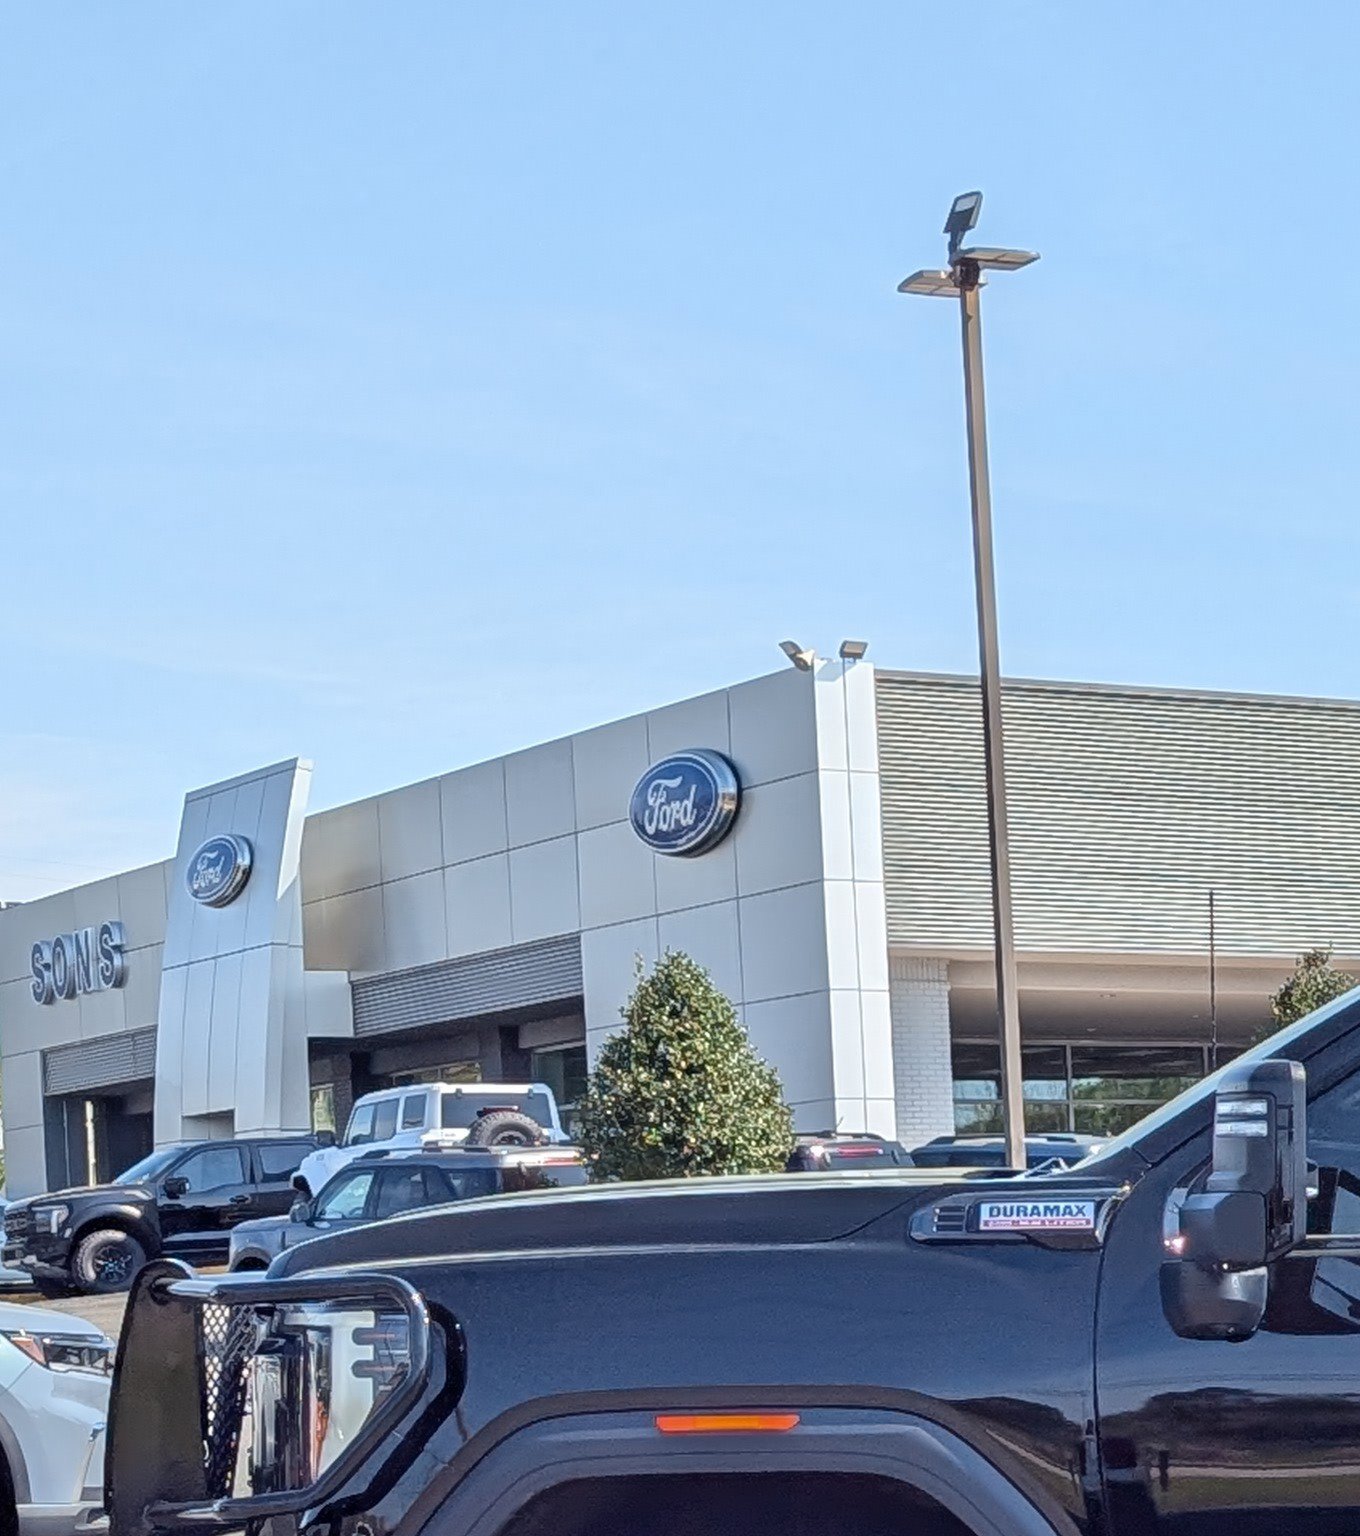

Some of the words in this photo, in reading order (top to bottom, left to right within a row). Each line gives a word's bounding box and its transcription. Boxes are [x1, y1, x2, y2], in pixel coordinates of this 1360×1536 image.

[643, 776, 698, 835] Ford
[193, 850, 225, 890] Ford
[30, 920, 122, 1005] SONS
[988, 1204, 1087, 1218] DURAMAX
